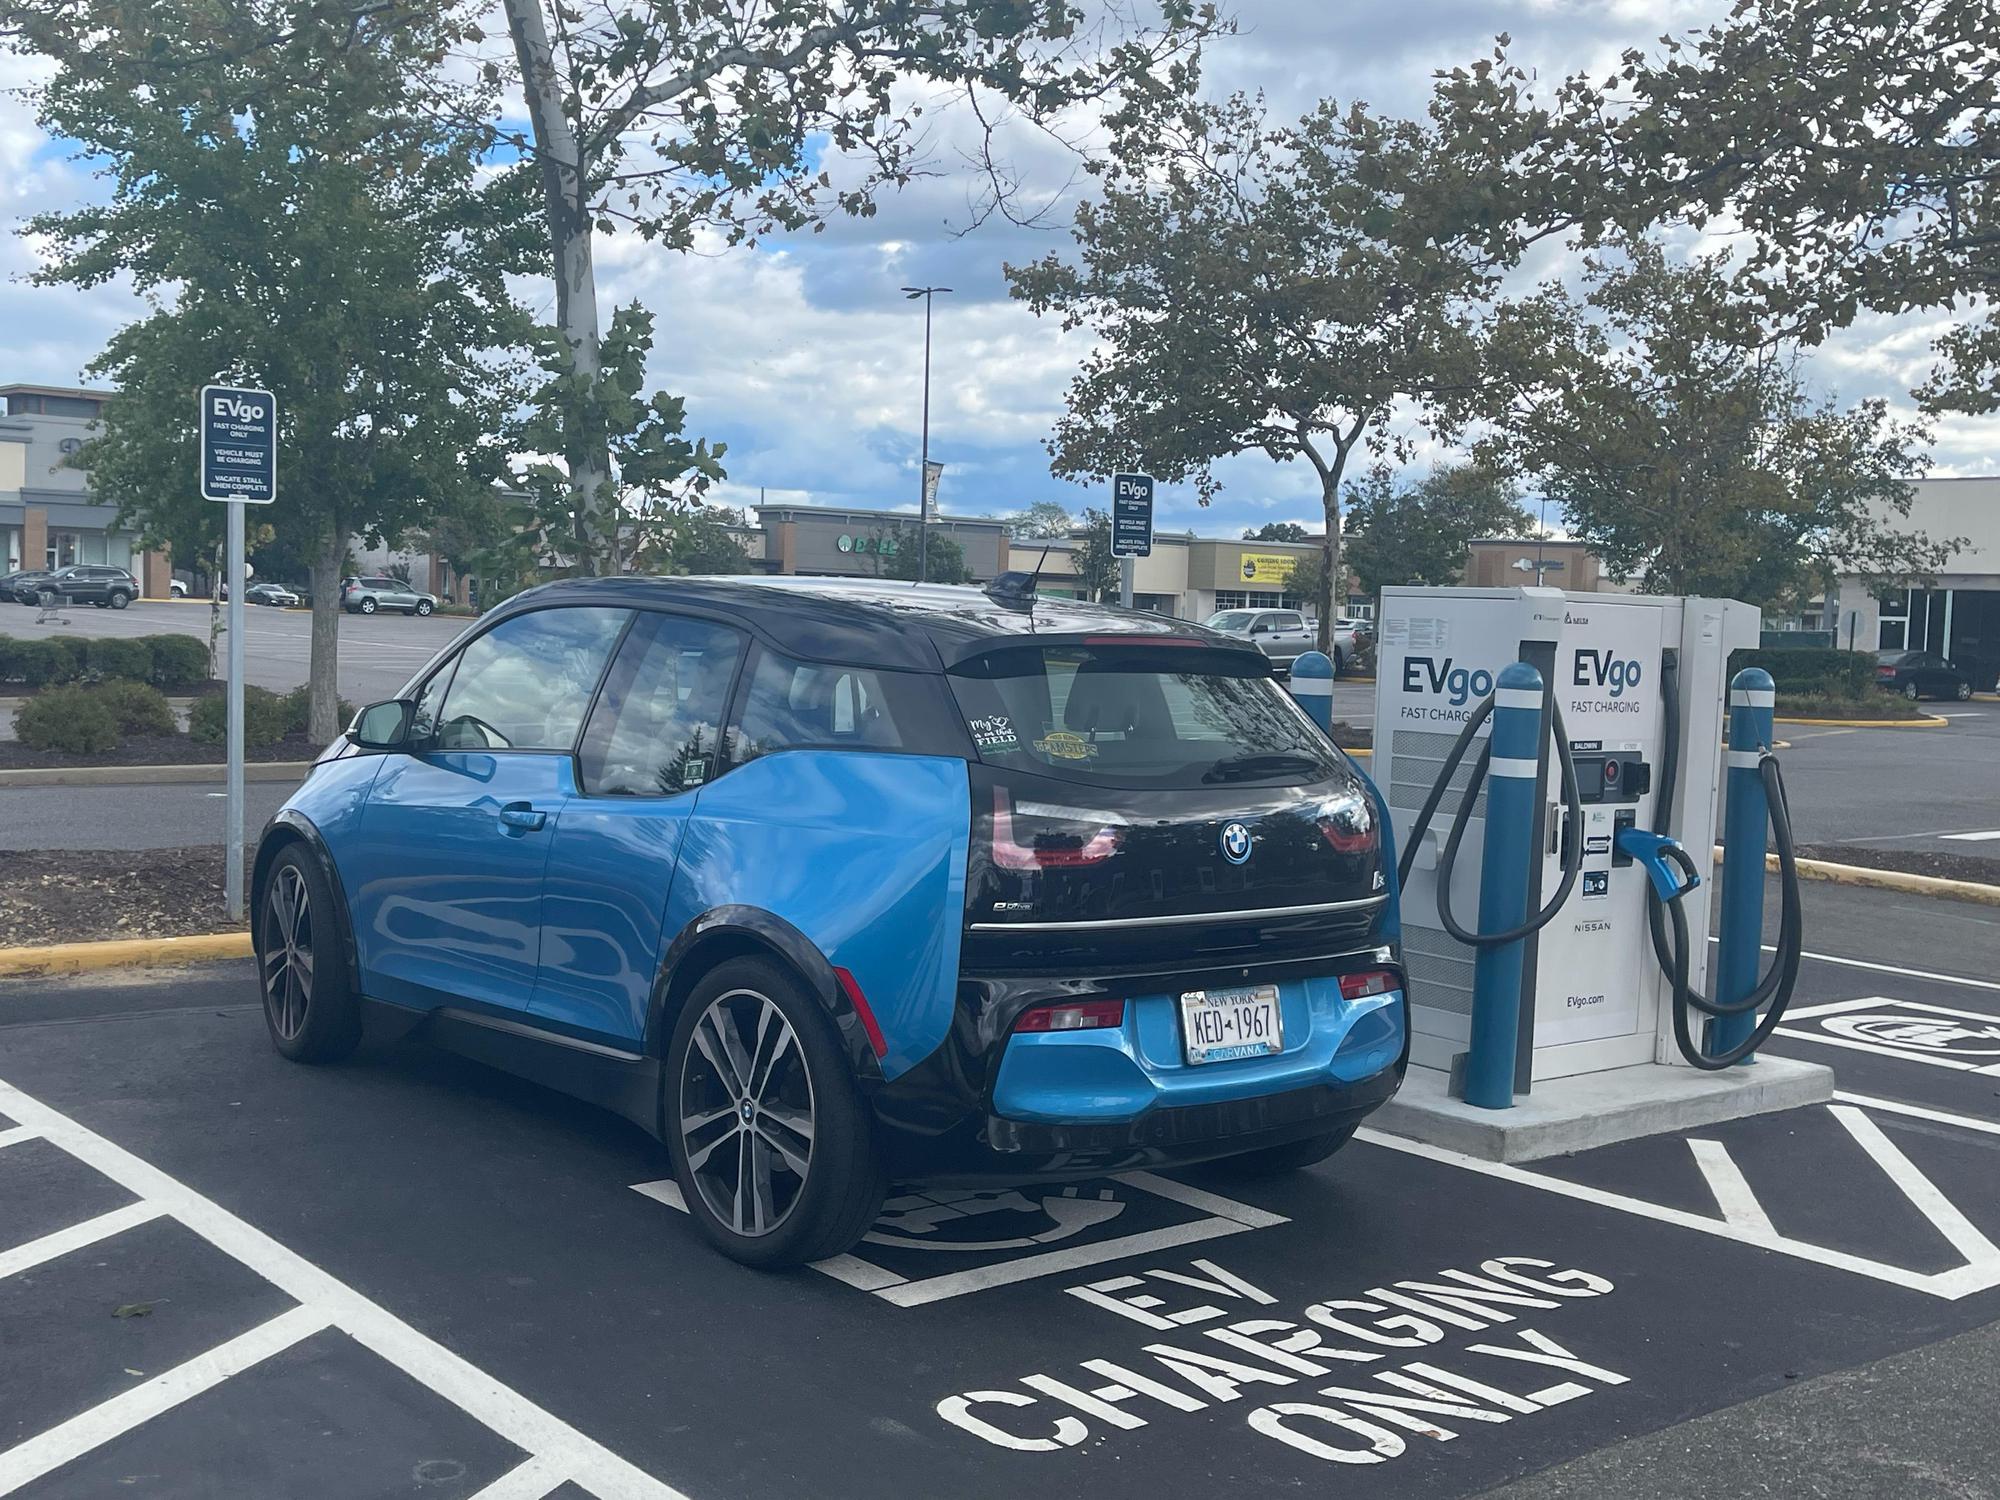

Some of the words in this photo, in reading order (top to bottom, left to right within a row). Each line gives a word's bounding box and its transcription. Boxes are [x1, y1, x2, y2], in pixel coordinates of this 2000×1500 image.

[213, 397, 264, 423] EVgo
[230, 424, 265, 432] CHARGING
[214, 448, 243, 457] VEHICLE
[226, 456, 261, 465] CHARGING
[231, 482, 268, 492] COMPLETE
[1119, 481, 1148, 499] EVgo
[1402, 655, 1493, 706] EVgo
[1573, 649, 1642, 698] EVgo
[1571, 701, 1593, 713] FAST
[1594, 701, 1640, 713] CHARGING
[1400, 706, 1428, 719] FAST
[1429, 708, 1492, 724] CHARGG
[976, 734, 1017, 746] FIELD
[1574, 742, 1598, 750] BALDWIN
[1574, 922, 1612, 932] NISSAN
[1207, 996, 1227, 1008] NEW
[1230, 993, 1255, 1005] YORK
[1567, 994, 1605, 1009] EVgo.com
[1193, 1010, 1224, 1045] KED
[1233, 1004, 1270, 1040] 1967
[1213, 1045, 1262, 1060] CARVANA
[1064, 1259, 1279, 1331] EV
[936, 1256, 1614, 1452] CHARGING
[1247, 1328, 1631, 1465] ONLY
